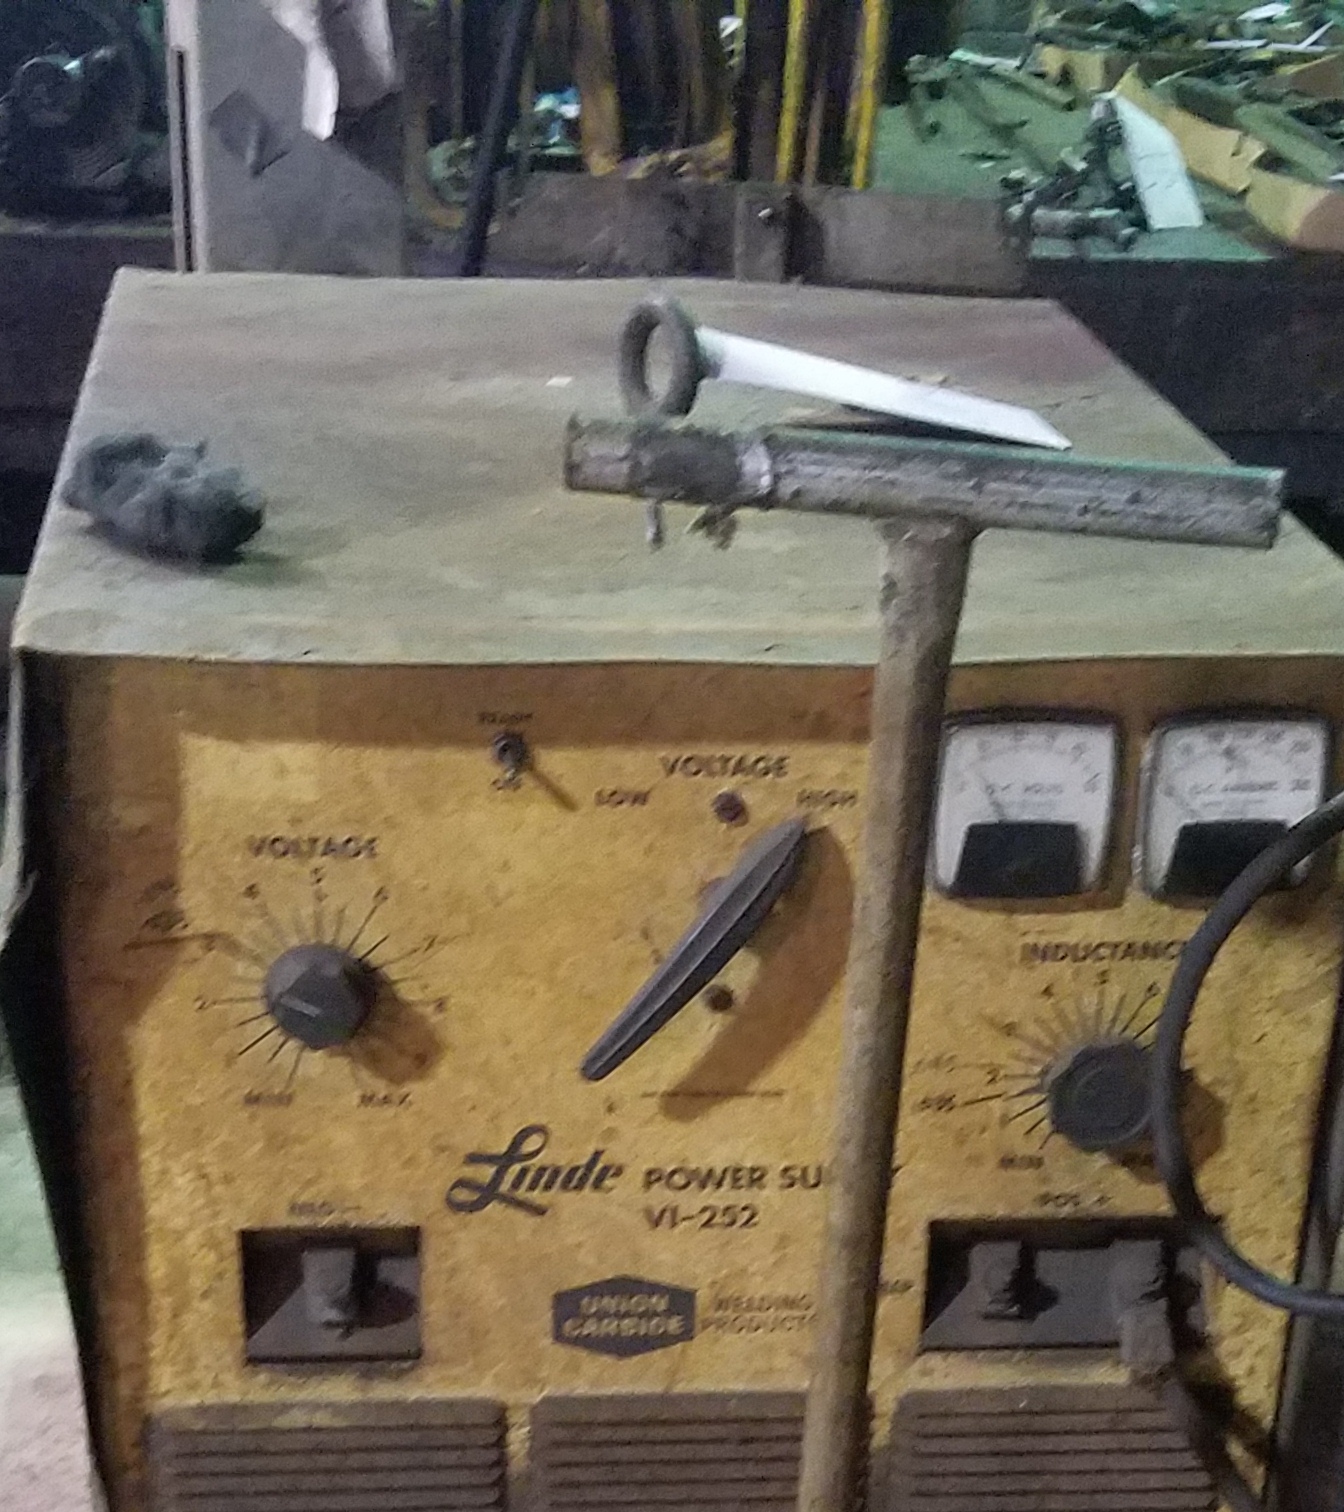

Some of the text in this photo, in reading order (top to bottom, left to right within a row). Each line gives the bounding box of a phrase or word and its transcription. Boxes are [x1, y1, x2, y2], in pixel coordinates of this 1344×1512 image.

[658, 754, 790, 779] VOLTAGE
[248, 835, 378, 858] VOLTAGE
[1020, 940, 1188, 963] INDUCTANC
[445, 1124, 625, 1216] Linde
[641, 1165, 767, 1192] POWER
[643, 1205, 759, 1230] VI-252
[579, 1295, 670, 1317] UNION
[714, 1294, 813, 1313] WELDING
[562, 1316, 686, 1339] CARBIDE
